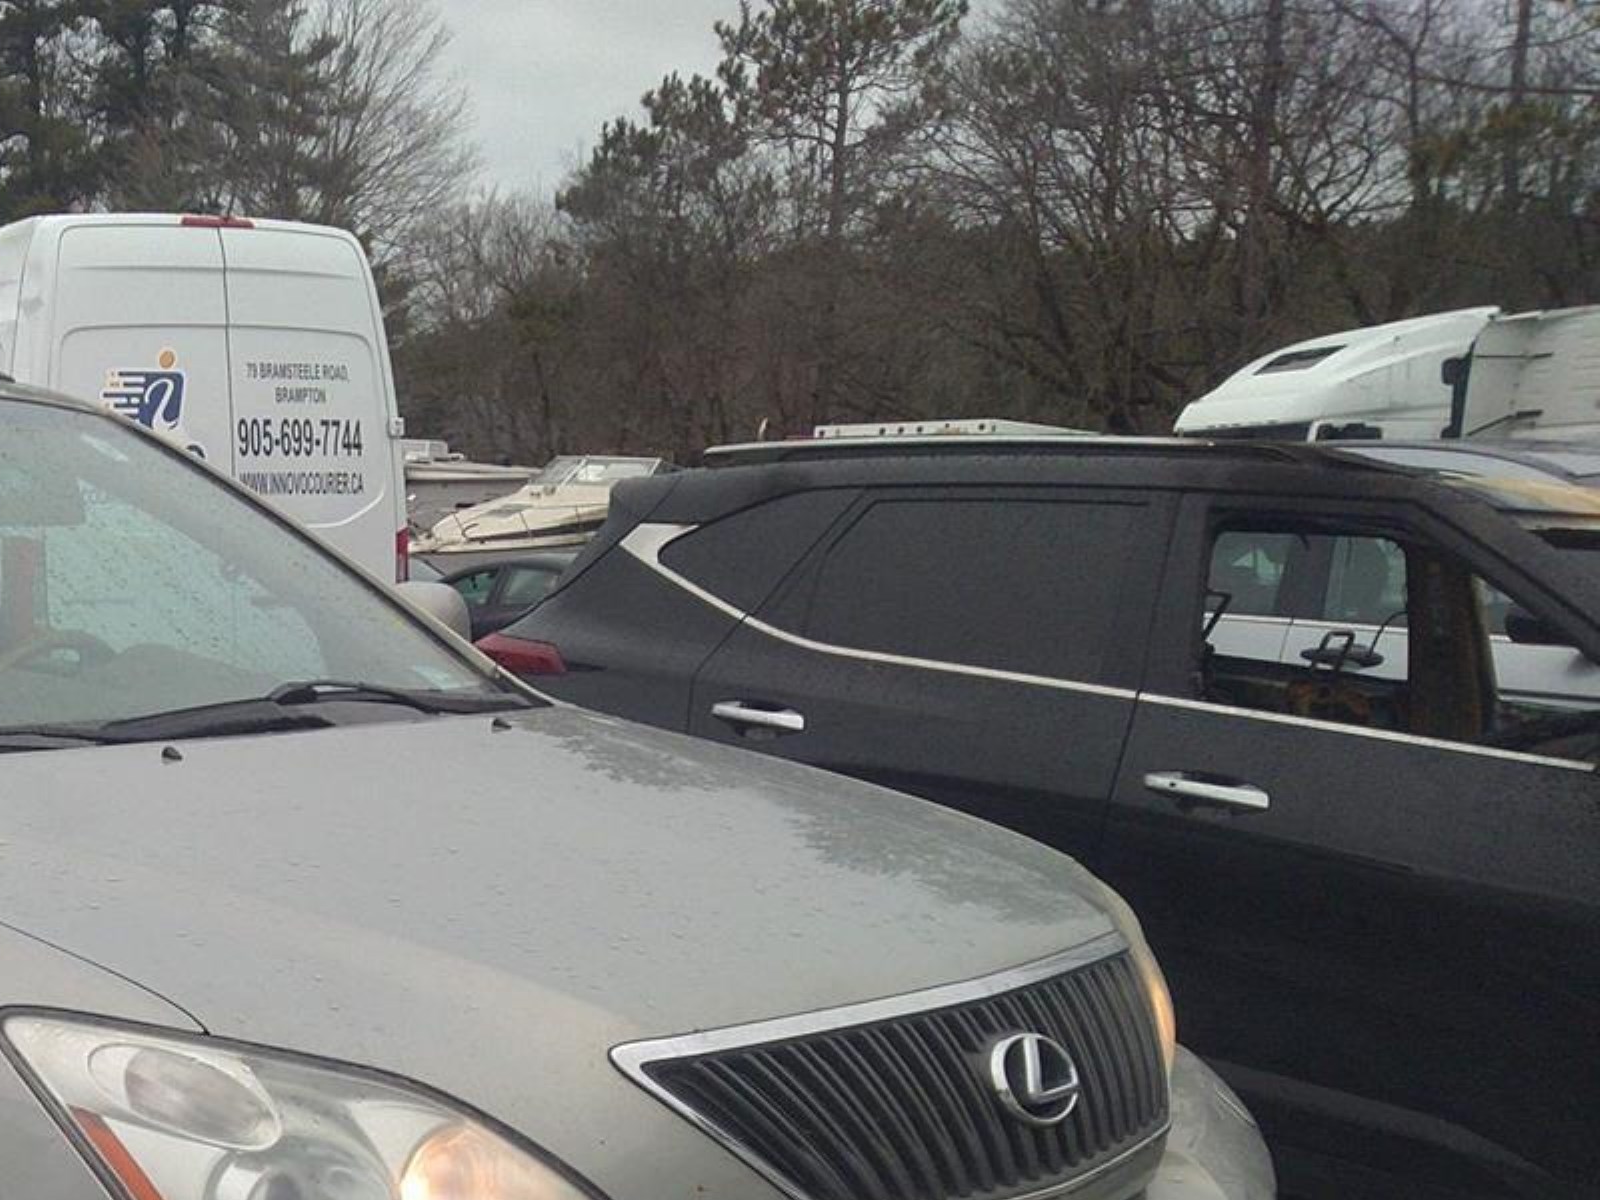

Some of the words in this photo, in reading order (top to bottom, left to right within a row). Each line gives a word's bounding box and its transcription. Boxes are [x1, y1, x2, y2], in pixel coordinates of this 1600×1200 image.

[246, 362, 258, 379] 79
[259, 361, 321, 380] BRAMSTEELE
[274, 386, 327, 403] BRAMPTON
[237, 416, 363, 457] 905-699-7744
